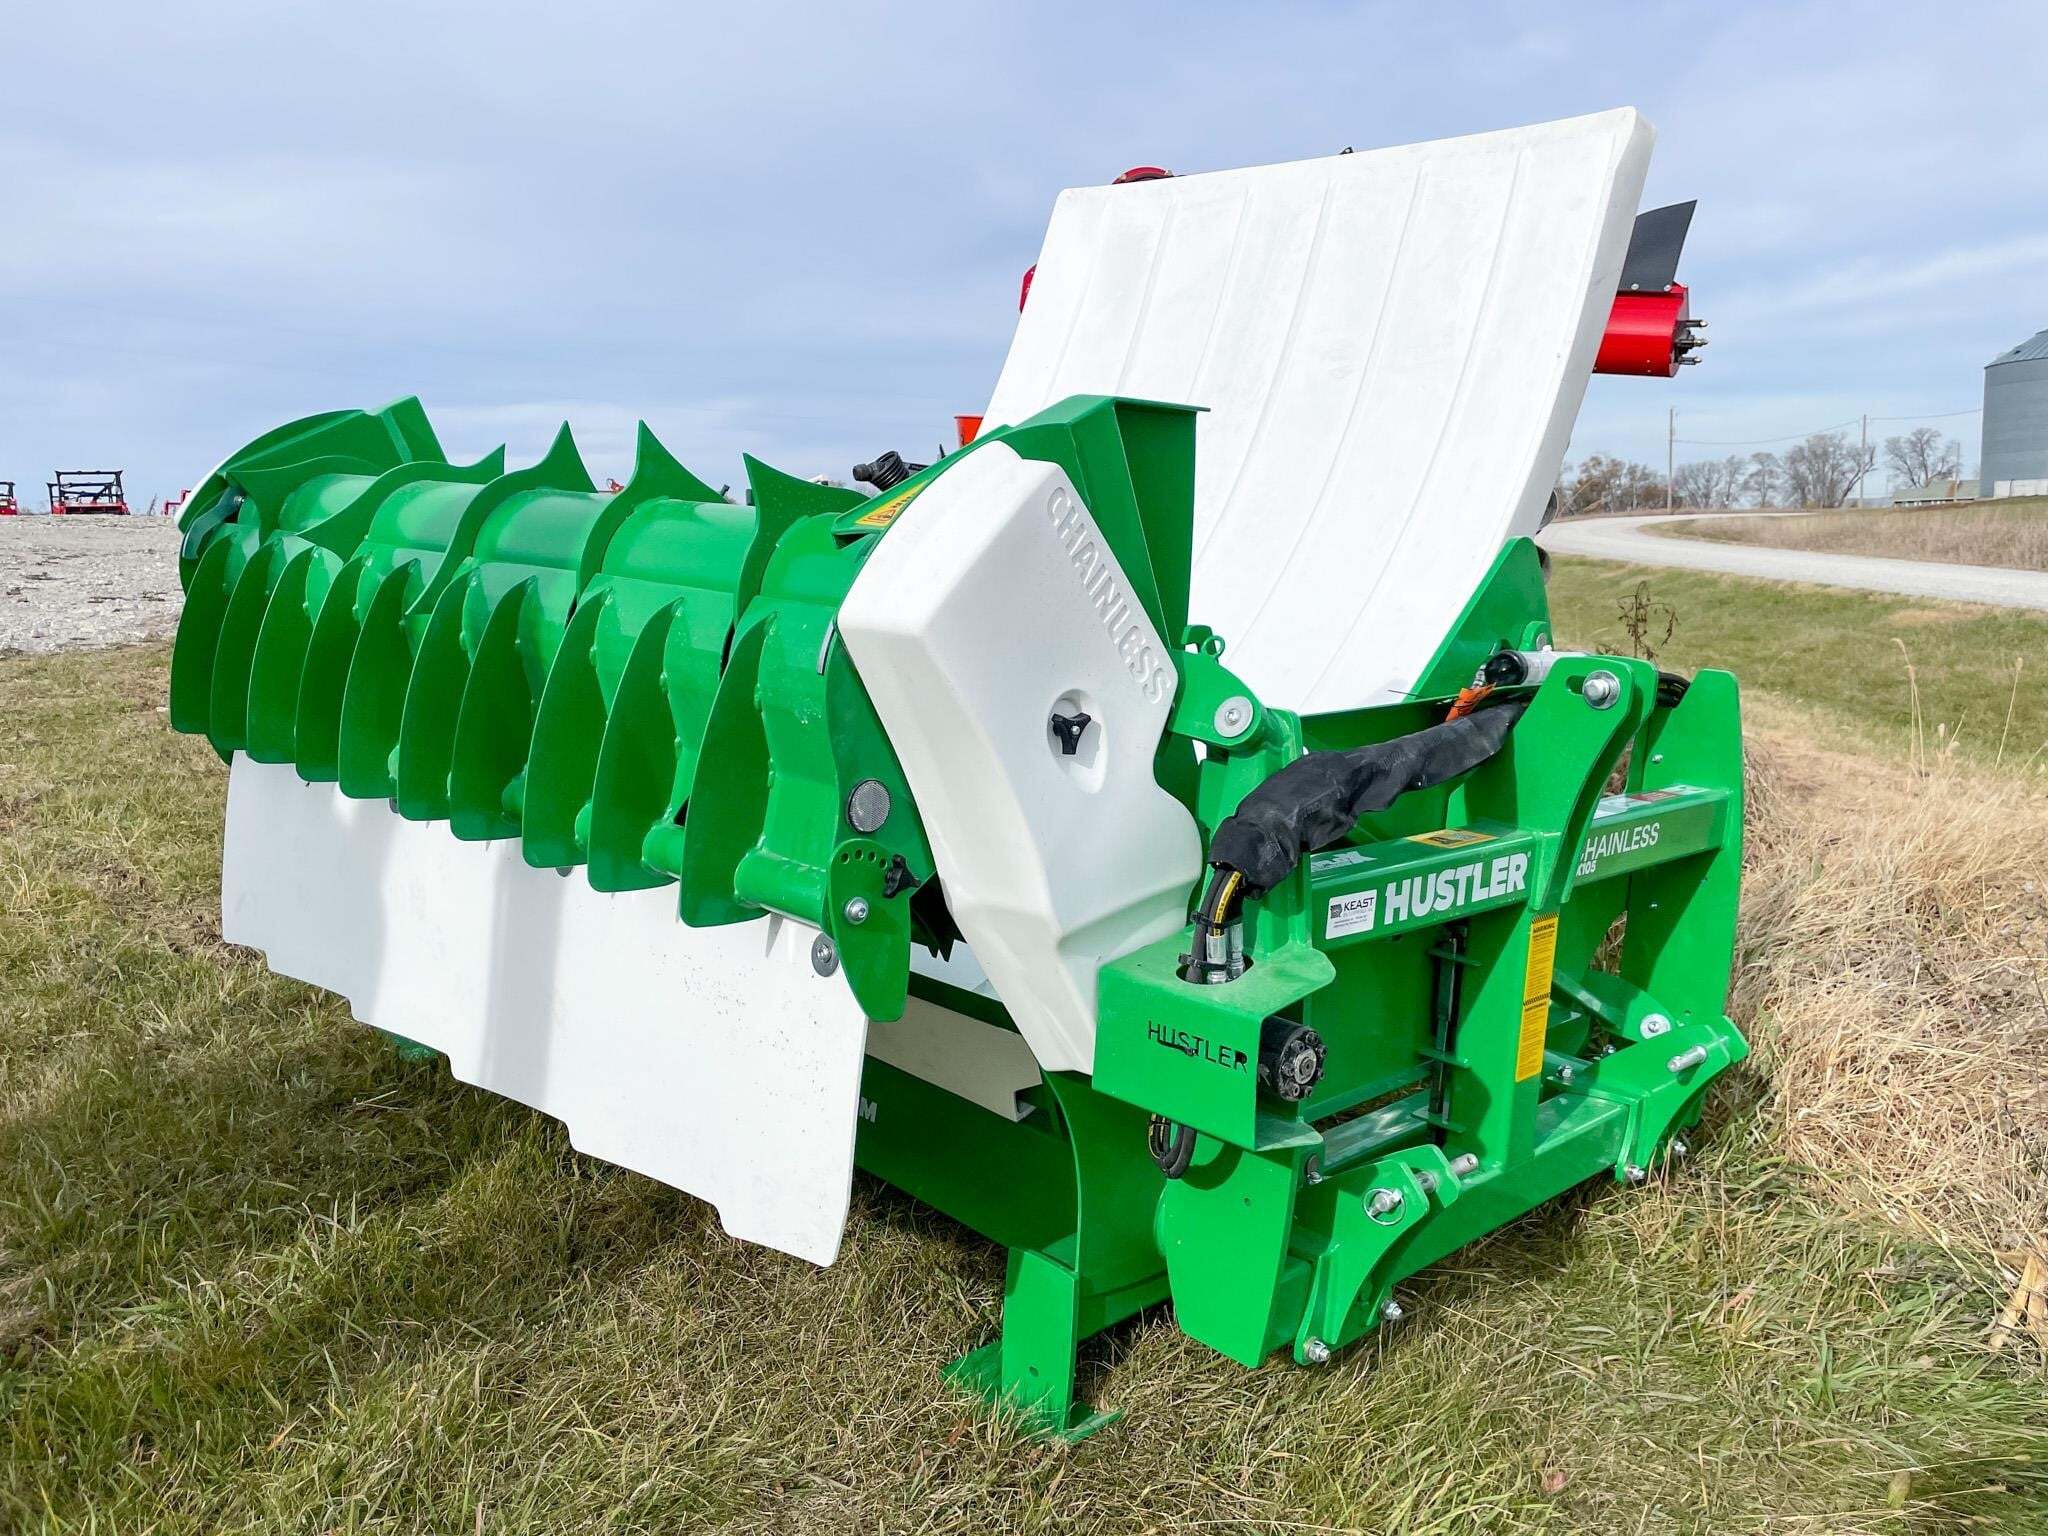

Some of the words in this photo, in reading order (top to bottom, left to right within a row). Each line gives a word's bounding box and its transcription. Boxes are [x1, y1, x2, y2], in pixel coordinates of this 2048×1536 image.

[1047, 487, 1172, 704] CHAINLESS
[1580, 822, 1660, 862] HAINLESS
[1344, 897, 1374, 911] KEAST
[1384, 853, 1528, 925] HUSTLER
[1148, 1020, 1247, 1073] HUSTLER
